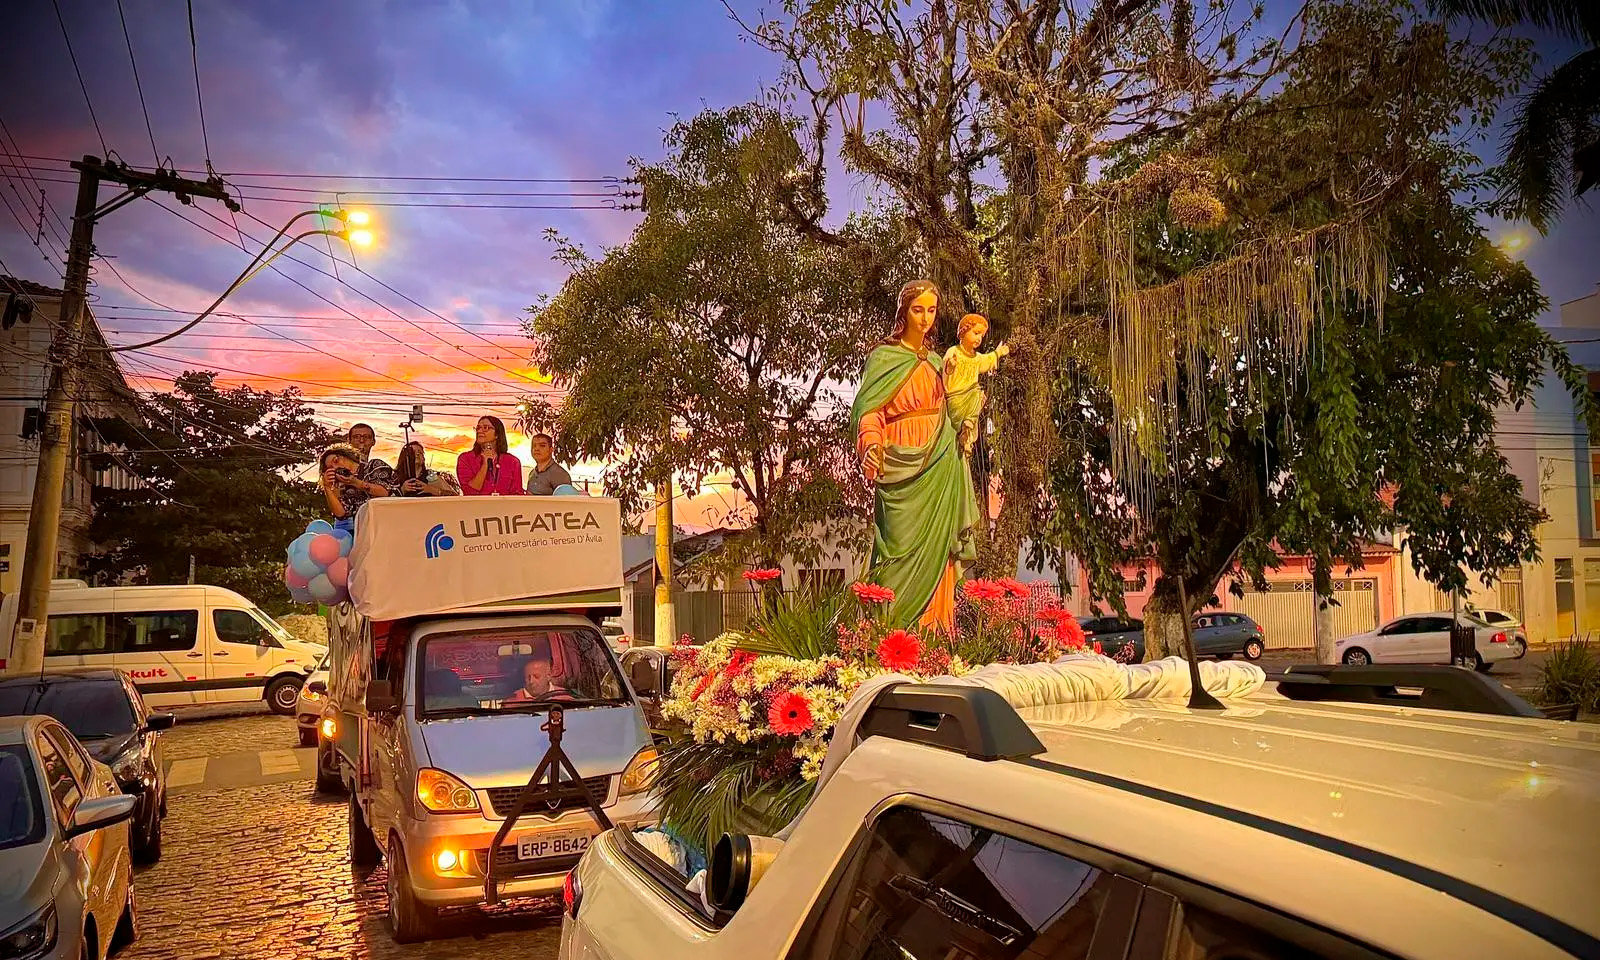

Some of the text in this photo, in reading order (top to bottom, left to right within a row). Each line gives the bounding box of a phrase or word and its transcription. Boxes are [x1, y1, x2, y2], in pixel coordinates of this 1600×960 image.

[460, 511, 600, 538] UNIFATEA
[463, 543, 493, 554] Centro
[494, 538, 548, 551] Universitário
[549, 536, 576, 546] Teresa
